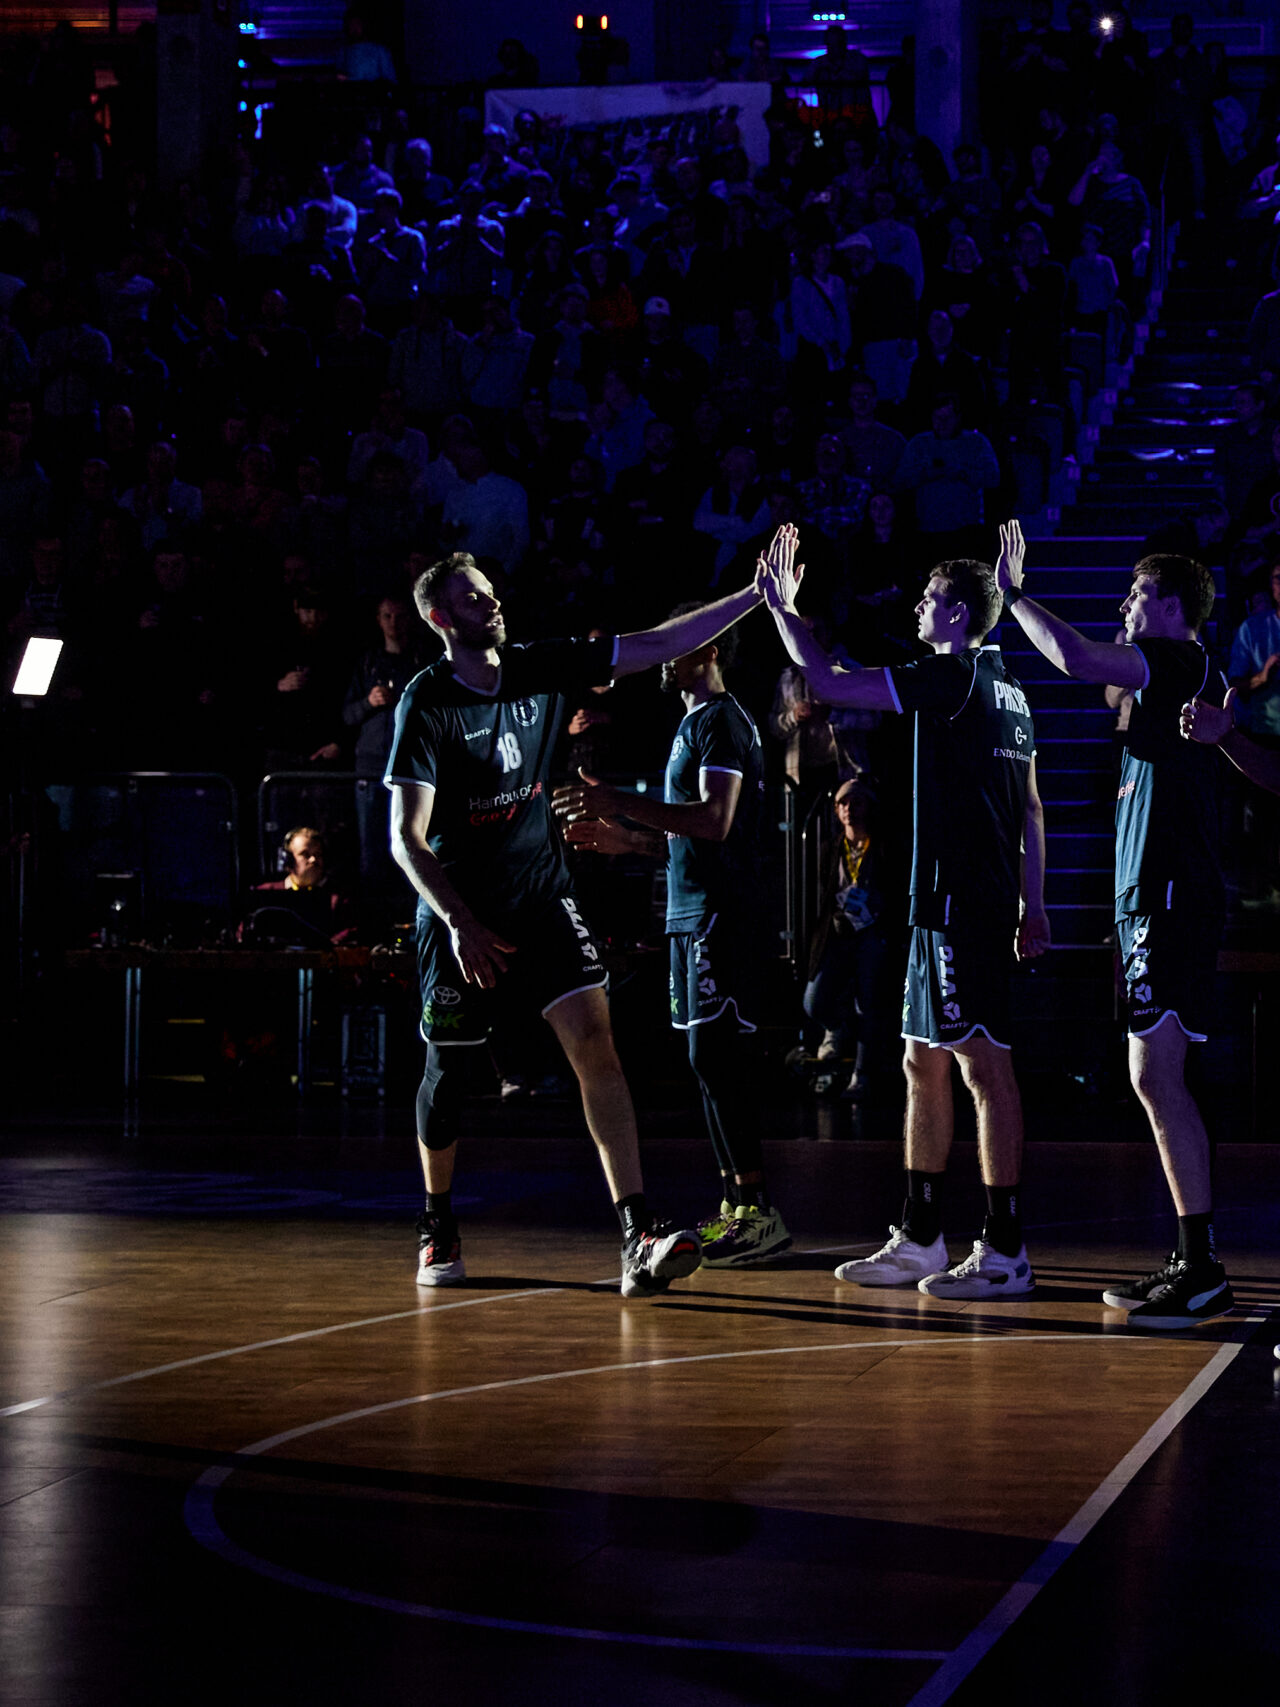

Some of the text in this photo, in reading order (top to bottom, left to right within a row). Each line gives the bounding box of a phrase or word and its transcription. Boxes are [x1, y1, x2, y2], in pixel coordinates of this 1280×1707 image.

[497, 731, 522, 773] 18
[993, 747, 1015, 759] ENDO
[939, 945, 957, 997] VTG
